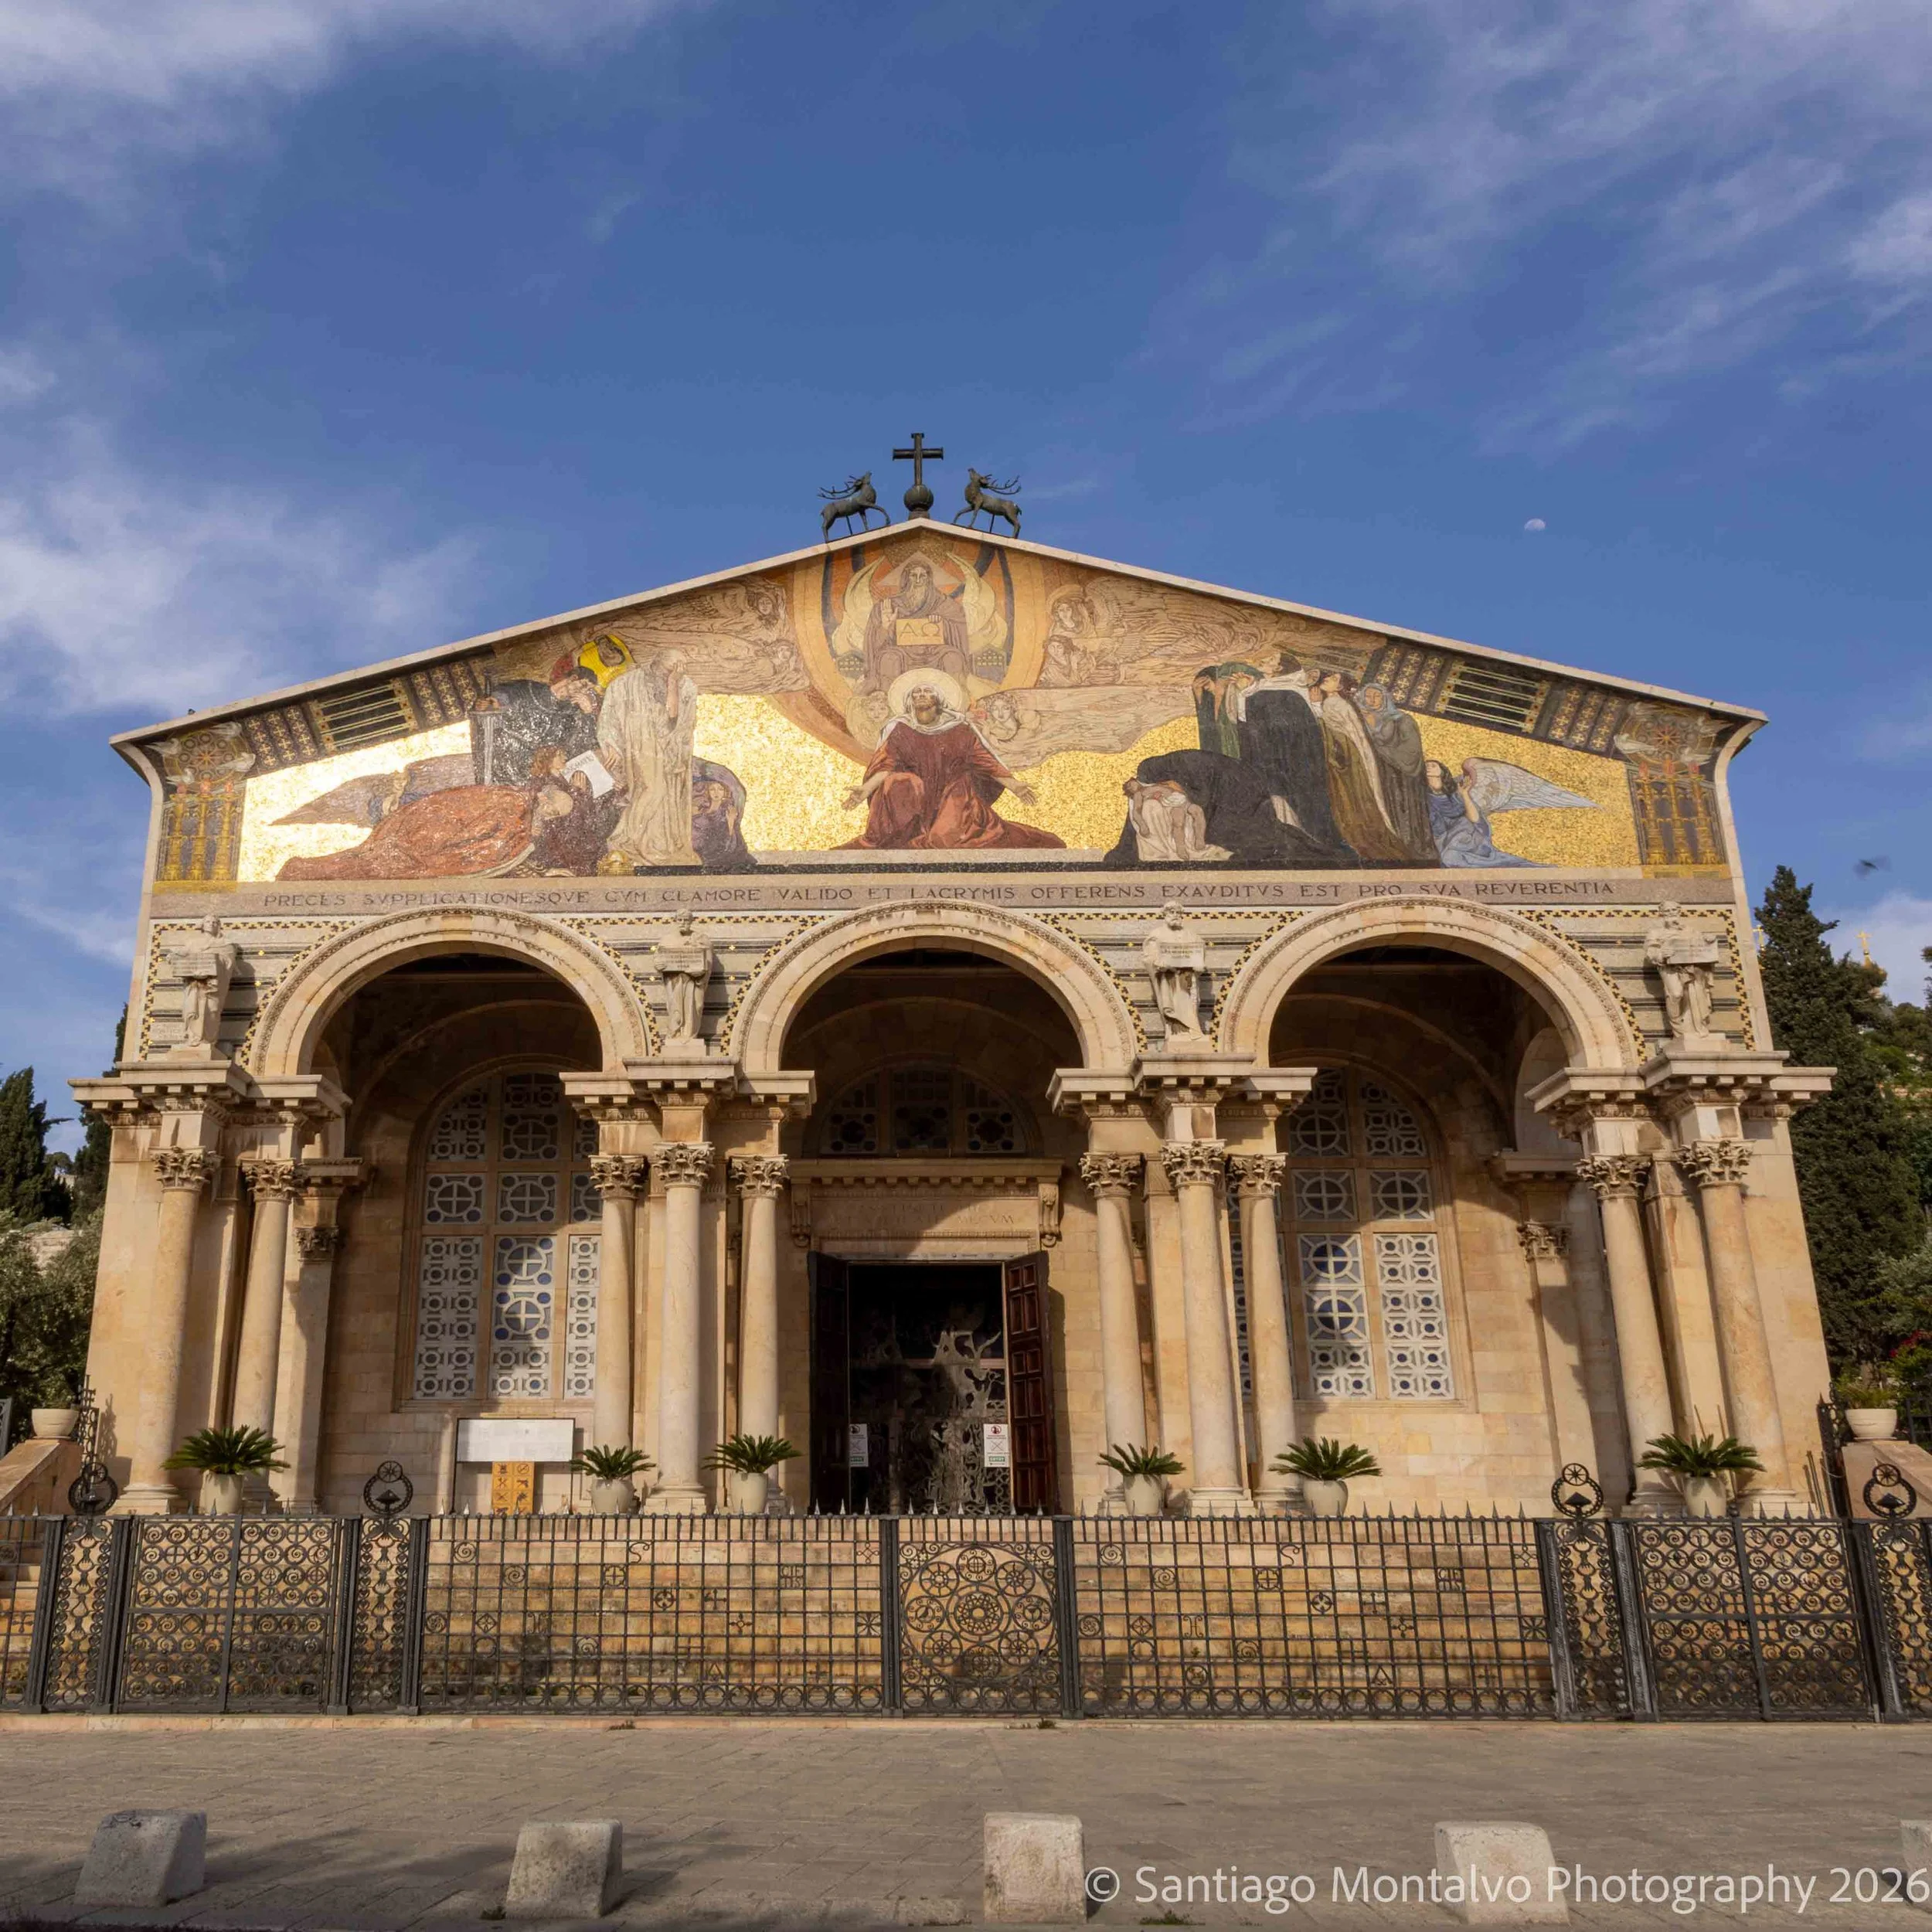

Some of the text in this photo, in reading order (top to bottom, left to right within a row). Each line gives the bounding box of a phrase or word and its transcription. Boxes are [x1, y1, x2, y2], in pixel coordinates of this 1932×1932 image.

[264, 881, 1614, 906] PRECES SVPPLICATIONESQVE CVM CLAMORE VALIDO ET LACRYMIS OFFERENS EXAVDITVS EST PRO SVA REVERENTIA
